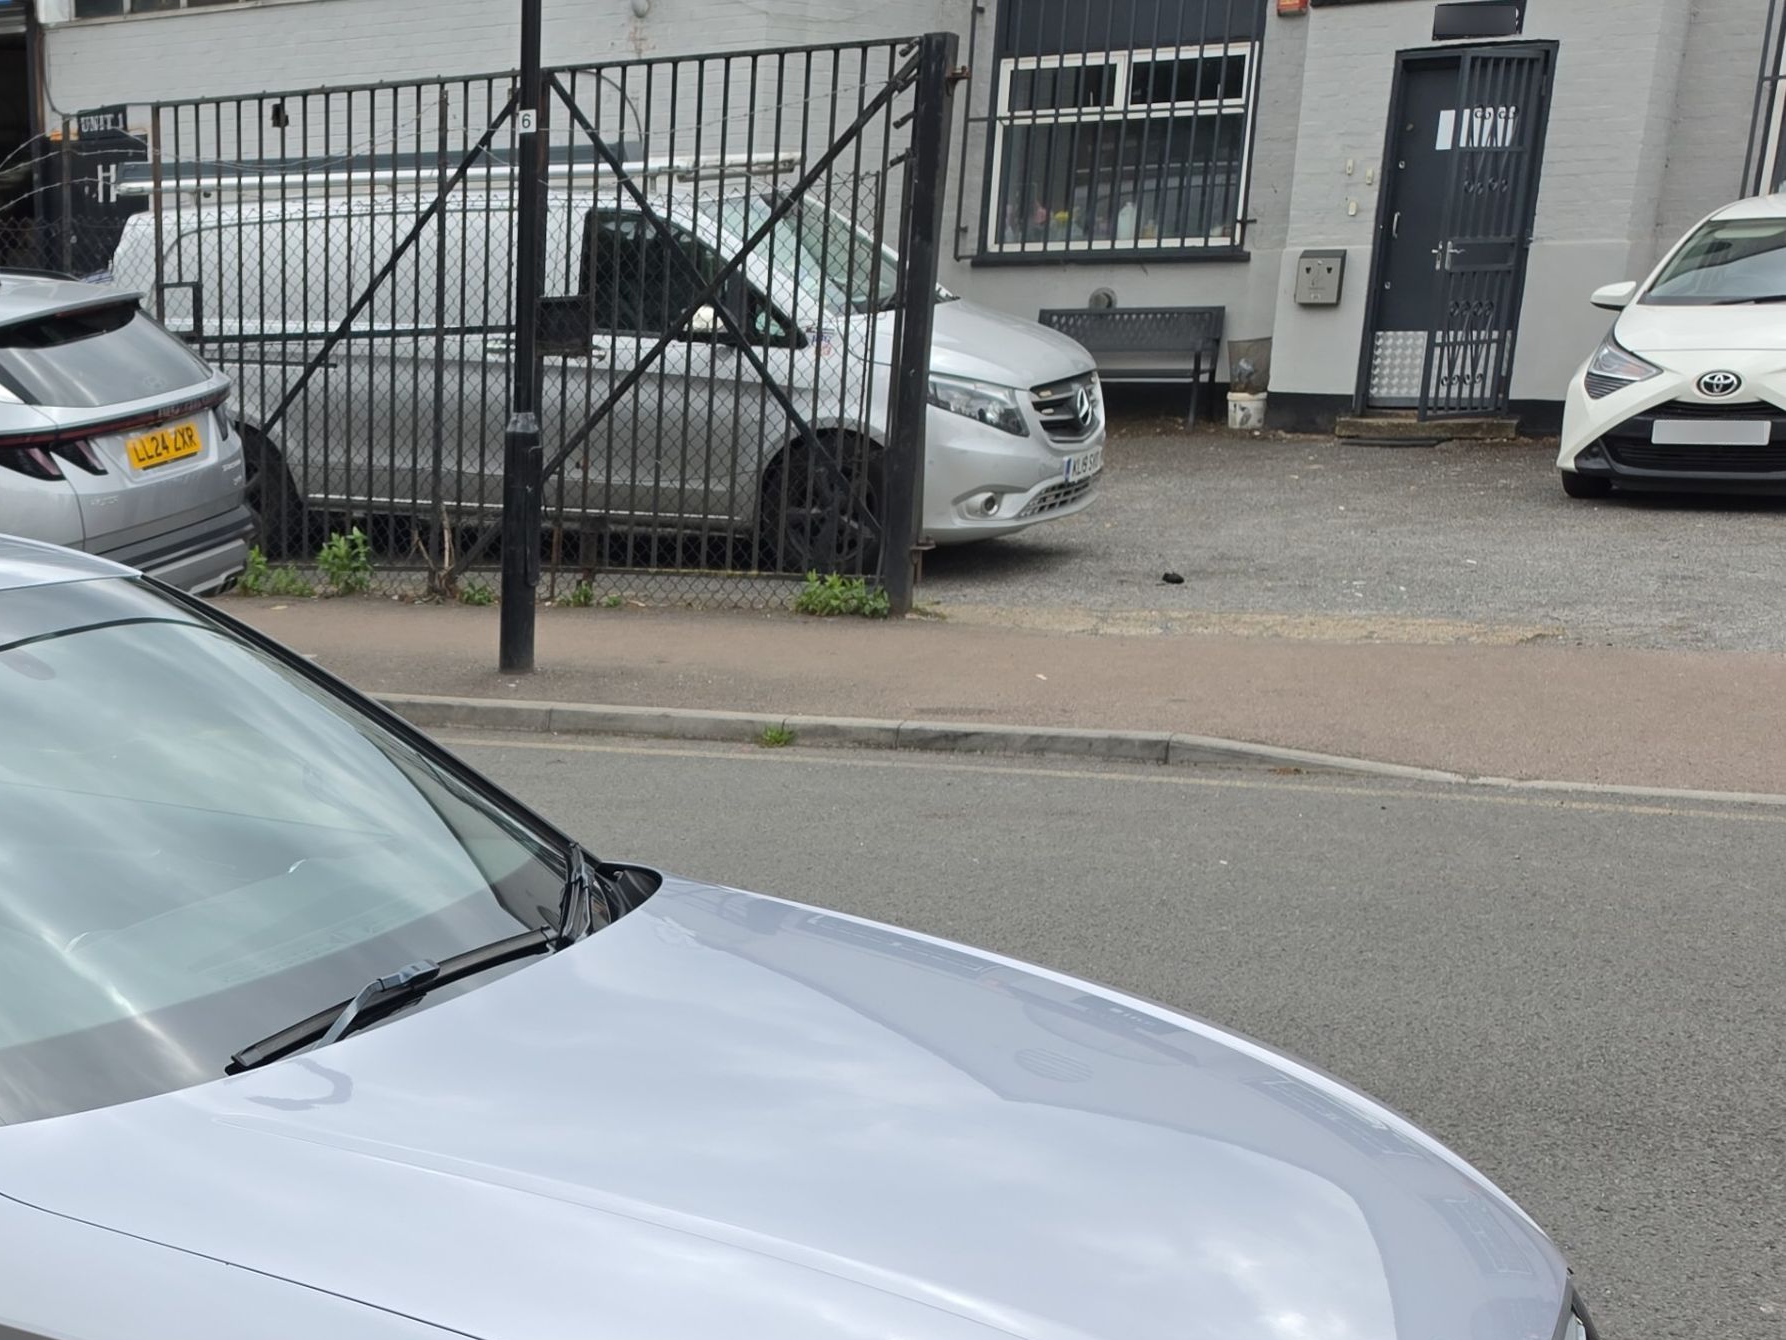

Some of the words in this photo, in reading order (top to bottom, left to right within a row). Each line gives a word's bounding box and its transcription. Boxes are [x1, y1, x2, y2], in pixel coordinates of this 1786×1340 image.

[80, 114, 114, 132] UNIT
[522, 113, 531, 129] 6
[132, 431, 171, 463] LL24
[174, 425, 198, 451] ZXR
